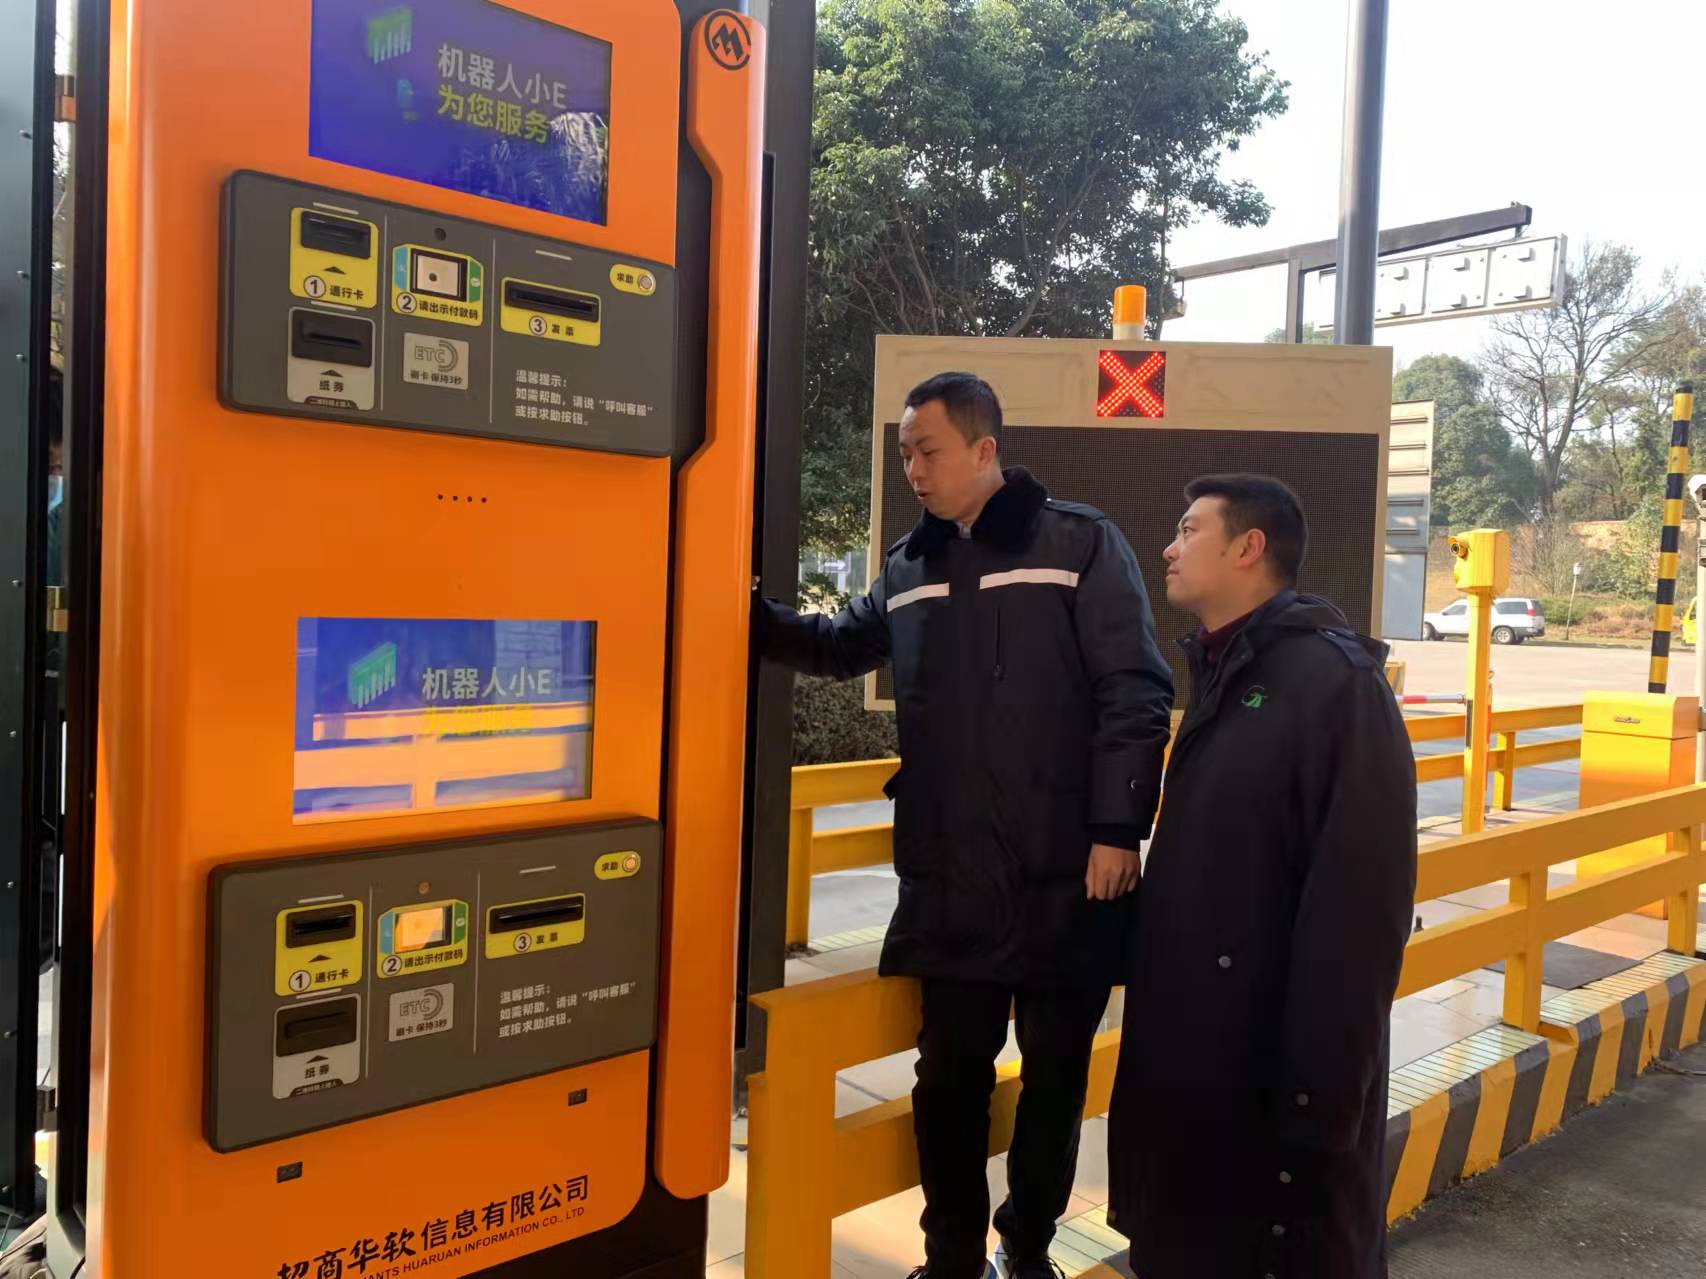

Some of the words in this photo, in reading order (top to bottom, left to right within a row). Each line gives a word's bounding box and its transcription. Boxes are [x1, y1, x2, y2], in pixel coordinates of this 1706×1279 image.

[438, 43, 567, 110] 机器人小E
[437, 84, 549, 144] 为您服务
[617, 272, 634, 285] 求助
[330, 285, 364, 300] 通行卡
[419, 300, 479, 320] 请出示付款码
[414, 345, 446, 364] ETC
[422, 666, 552, 701] 机器人小E
[404, 948, 464, 968] 请出示付款码
[315, 969, 349, 984] 通行卡
[400, 998, 431, 1017] ETC
[403, 1247, 462, 1273] HUARUAN
[465, 1222, 540, 1252] INFORMATION
[566, 1206, 585, 1220] LTD
